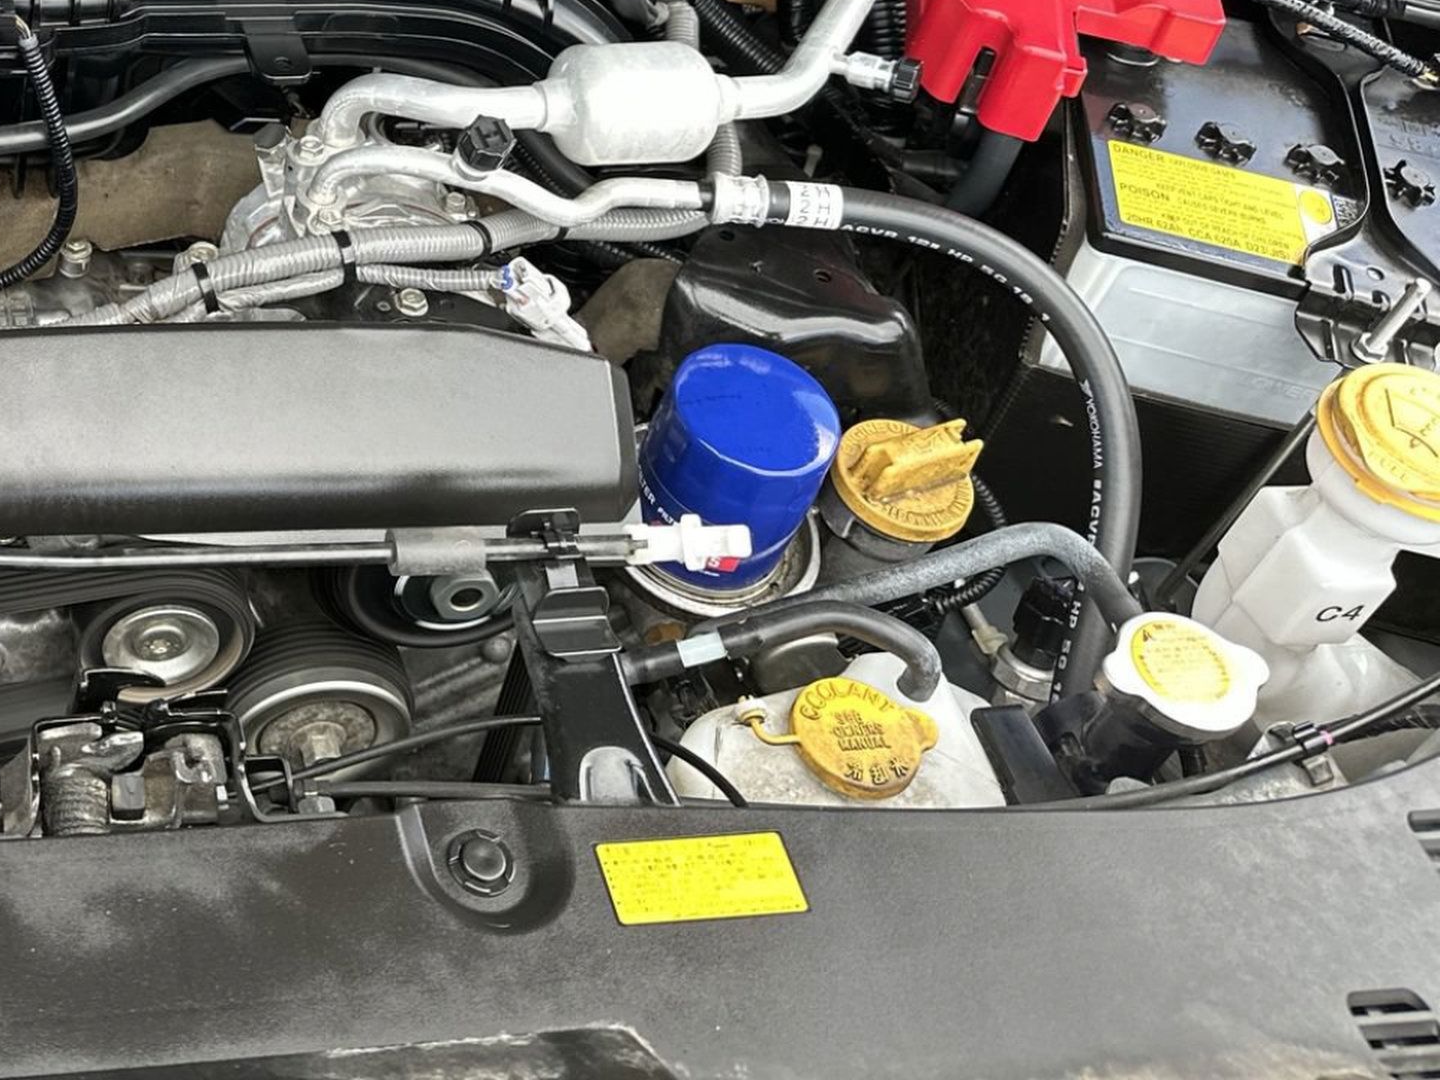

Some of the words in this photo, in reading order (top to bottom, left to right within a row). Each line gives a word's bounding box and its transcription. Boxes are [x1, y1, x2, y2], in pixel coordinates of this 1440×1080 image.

[1112, 142, 1165, 164] DANGER
[1118, 181, 1171, 202] POISON
[800, 199, 811, 214] 2
[817, 202, 830, 215] H
[841, 223, 898, 239] ACVR
[1085, 398, 1104, 469] YOKOHAMA
[1315, 604, 1365, 622] C4
[799, 682, 895, 720] COOLANT
[837, 736, 892, 752] MANUAL
